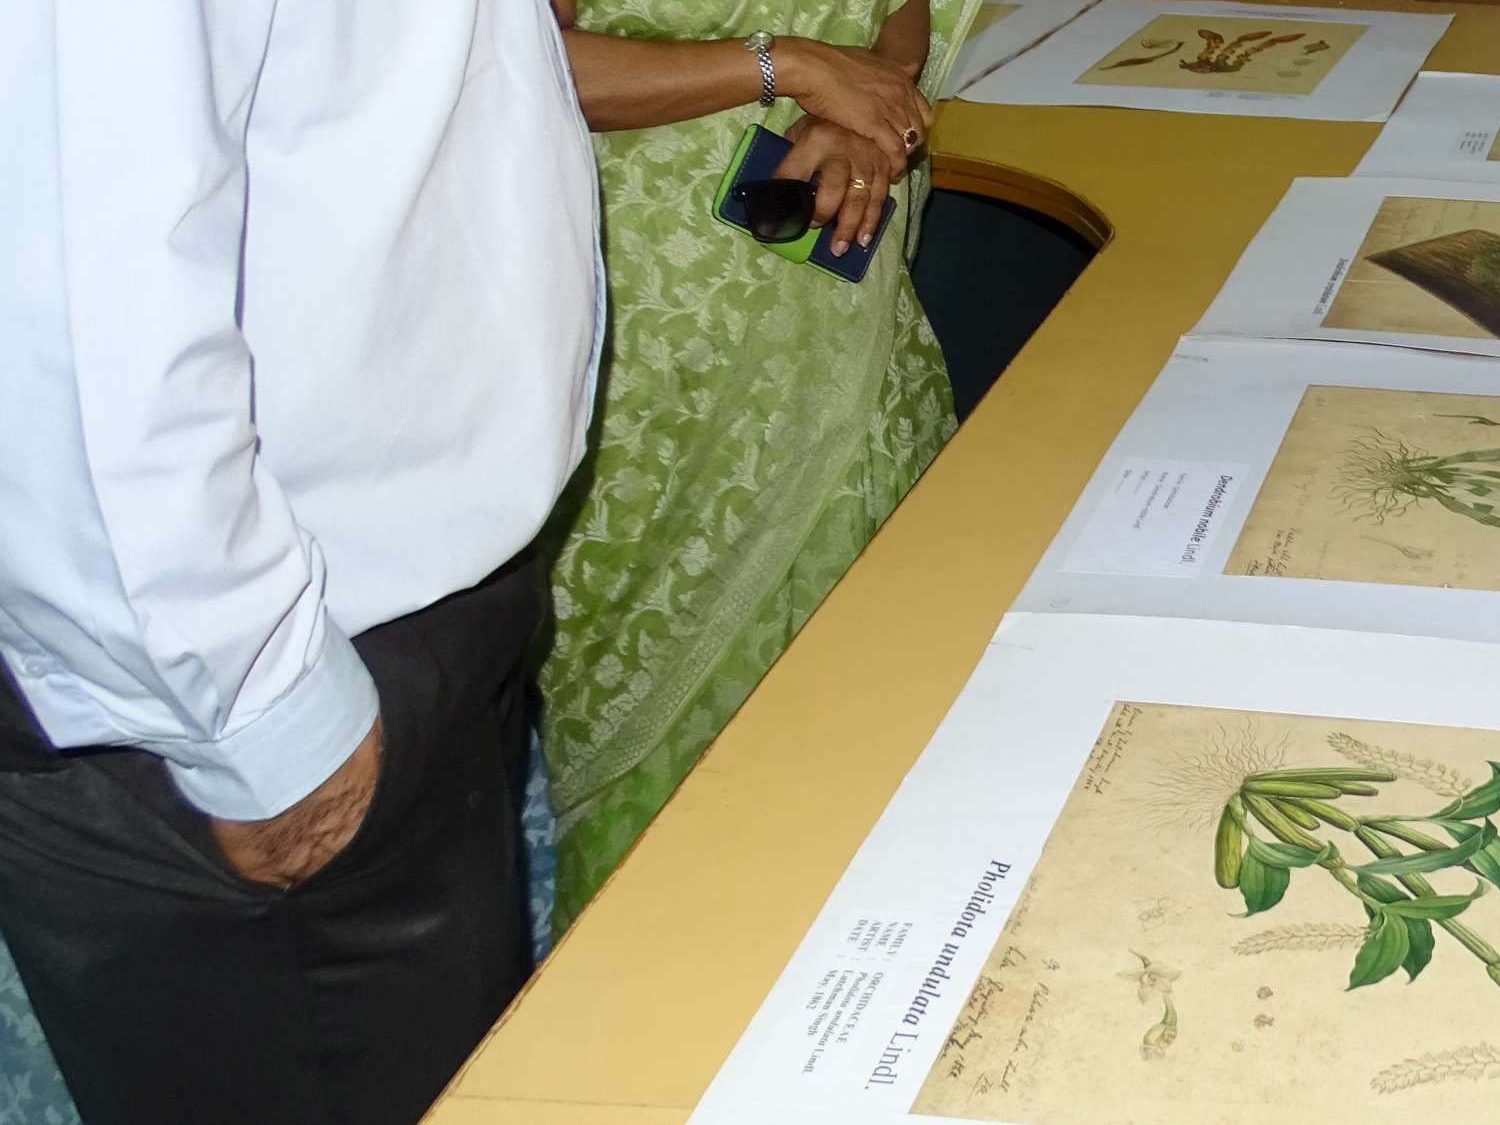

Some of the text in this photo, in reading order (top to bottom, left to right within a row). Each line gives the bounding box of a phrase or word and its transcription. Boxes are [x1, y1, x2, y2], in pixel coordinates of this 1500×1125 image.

[1202, 474, 1233, 518] Dendrobium
[1190, 518, 1209, 543] nobile
[951, 859, 1012, 938] Pholidota
[846, 919, 869, 942] DATE
[857, 921, 881, 951] ARTIST
[875, 921, 899, 947] NAME
[836, 922, 913, 1043] FAMILY ORCHIDACEAE
[839, 971, 868, 1008] Pholidota
[902, 943, 960, 1025] undulata
[818, 1010, 843, 1046] undulata
[864, 1031, 920, 1090] Lindl.
